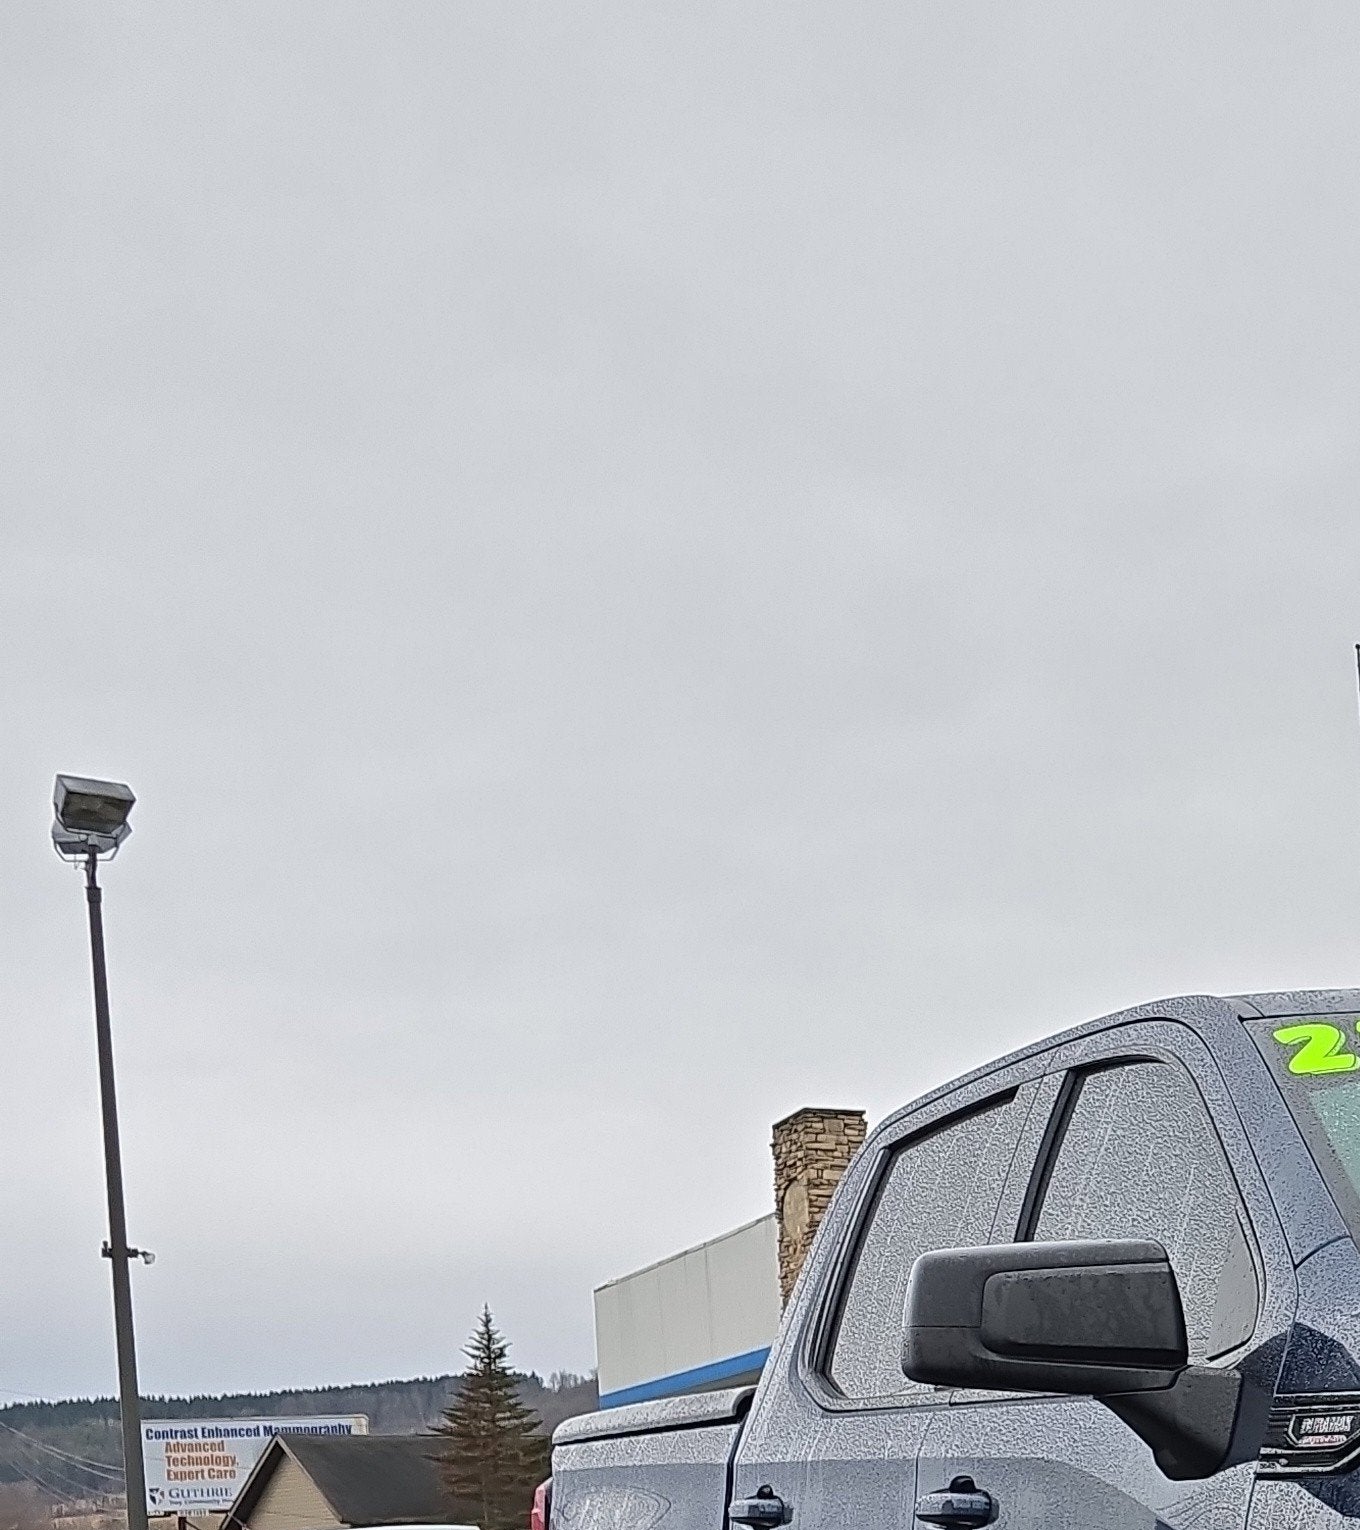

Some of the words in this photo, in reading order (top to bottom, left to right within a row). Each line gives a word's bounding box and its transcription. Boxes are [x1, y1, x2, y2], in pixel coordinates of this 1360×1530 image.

[145, 1427, 199, 1441] Contrast
[201, 1425, 260, 1438] Enhanced
[164, 1440, 225, 1453] Advanced
[166, 1468, 205, 1482] Expert
[207, 1467, 236, 1480] Care
